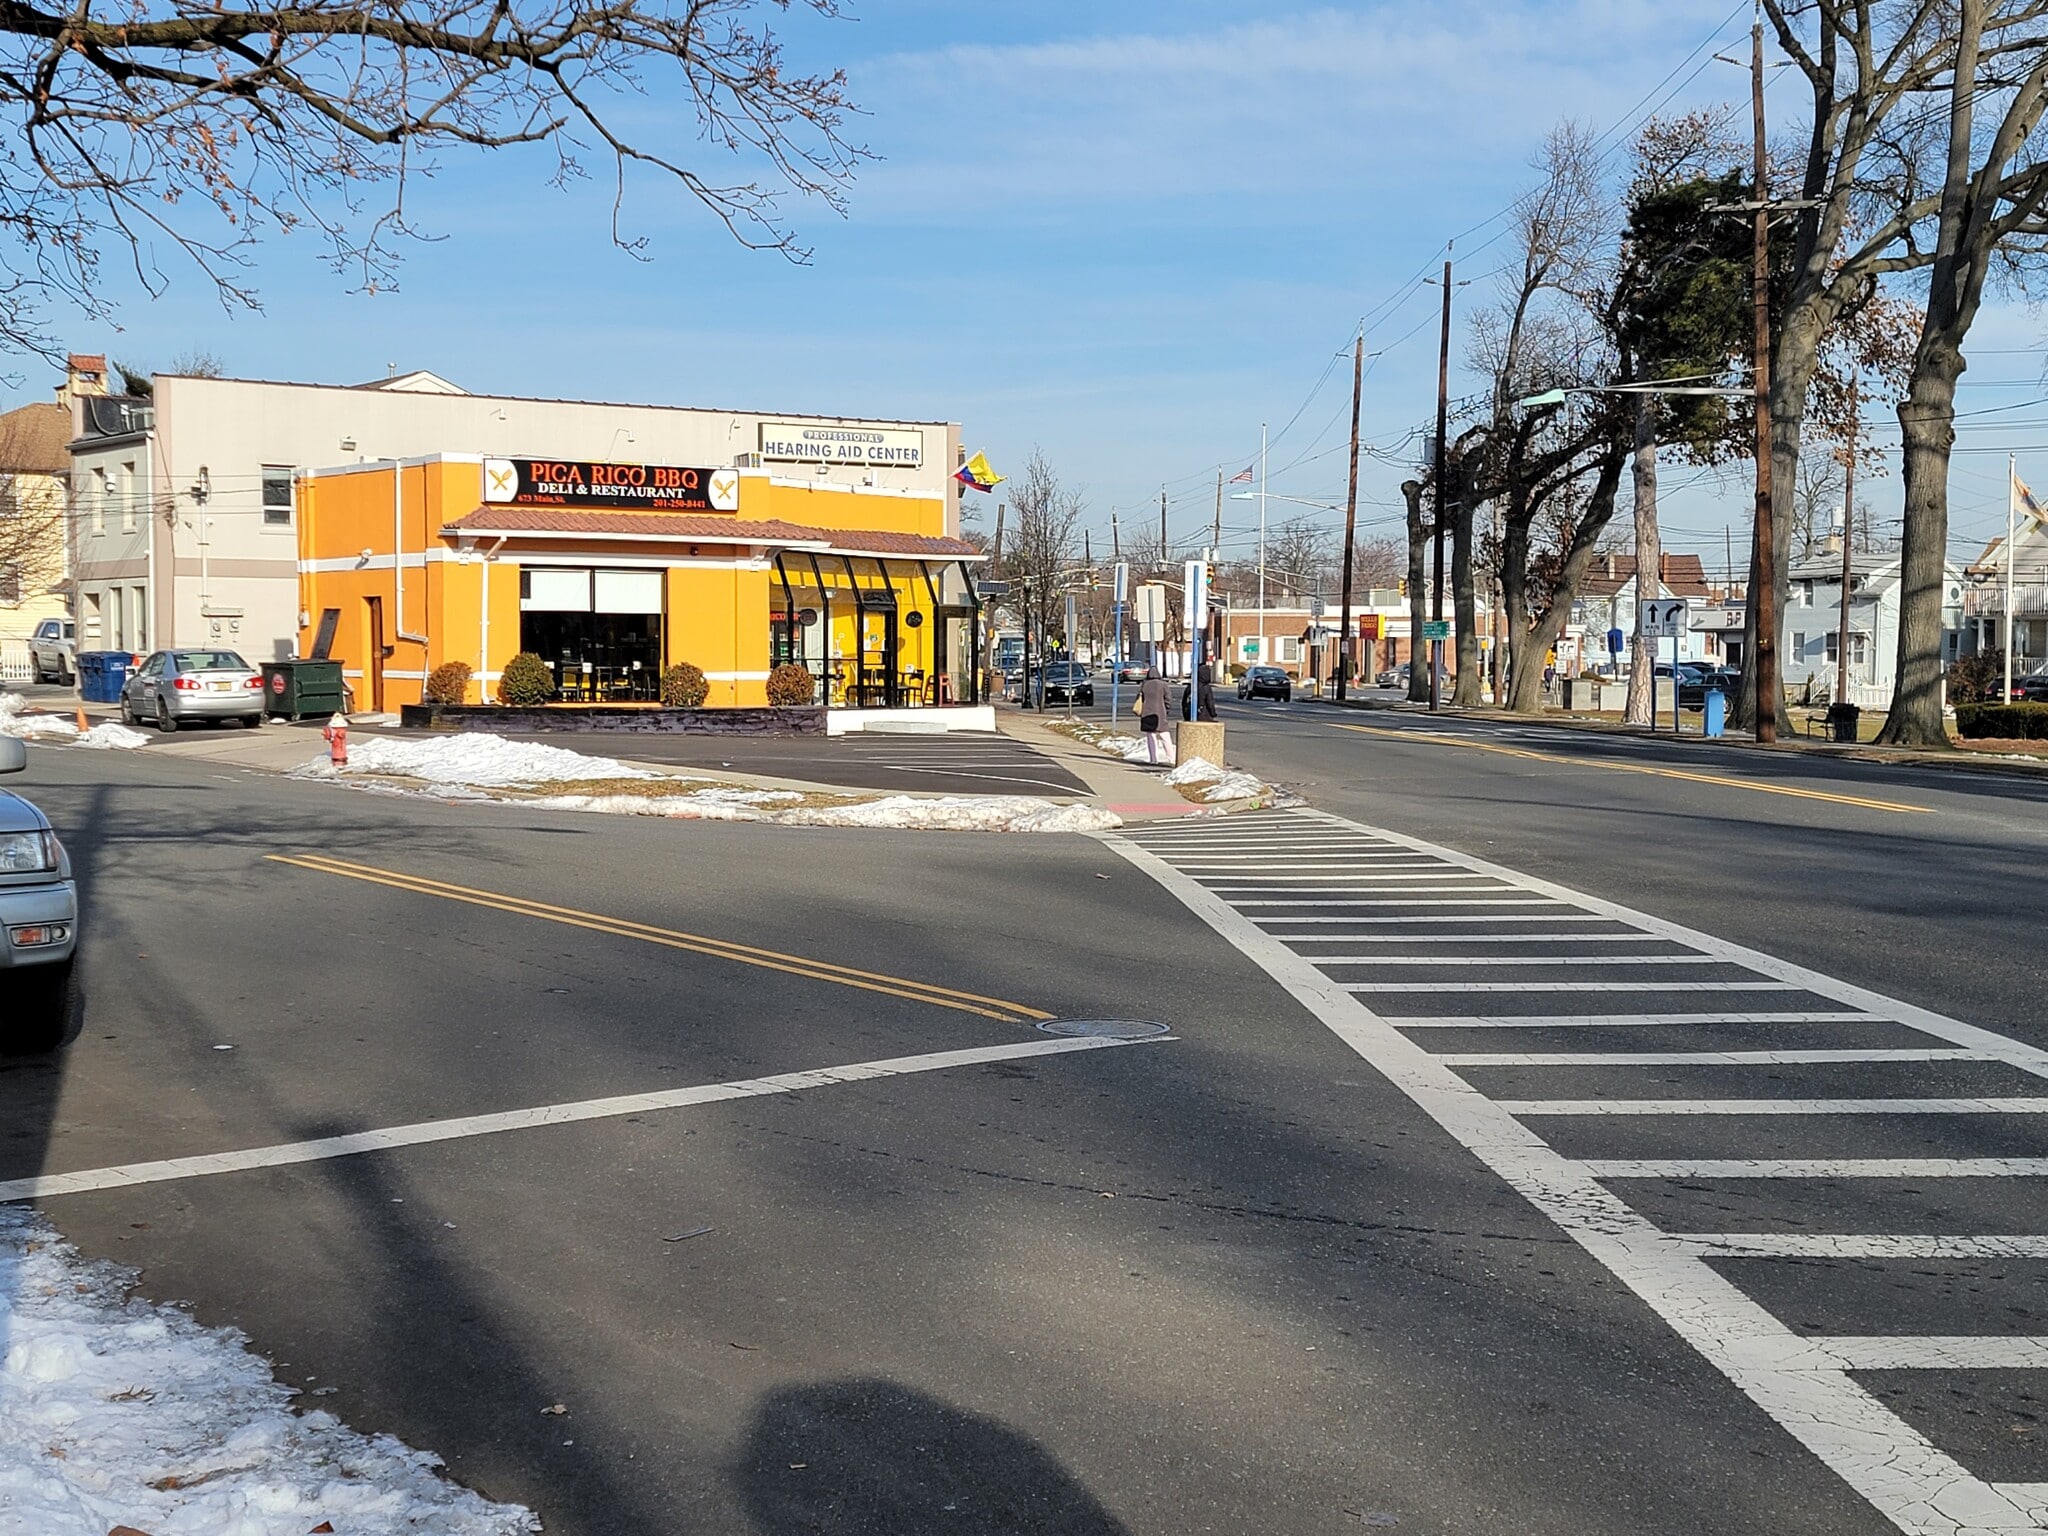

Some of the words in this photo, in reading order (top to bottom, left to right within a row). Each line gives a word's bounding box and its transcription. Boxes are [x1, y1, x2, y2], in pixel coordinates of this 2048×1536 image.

[808, 431, 880, 443] PROFESSIONAL
[765, 441, 832, 457] HEARING
[837, 445, 862, 458] AID
[868, 447, 919, 461] CENTER
[530, 463, 584, 484] PICA
[591, 465, 646, 486] RICO
[654, 468, 698, 490] BBQ
[538, 483, 573, 494] DELI
[576, 486, 588, 495] &
[591, 484, 686, 499] RESTAURANT
